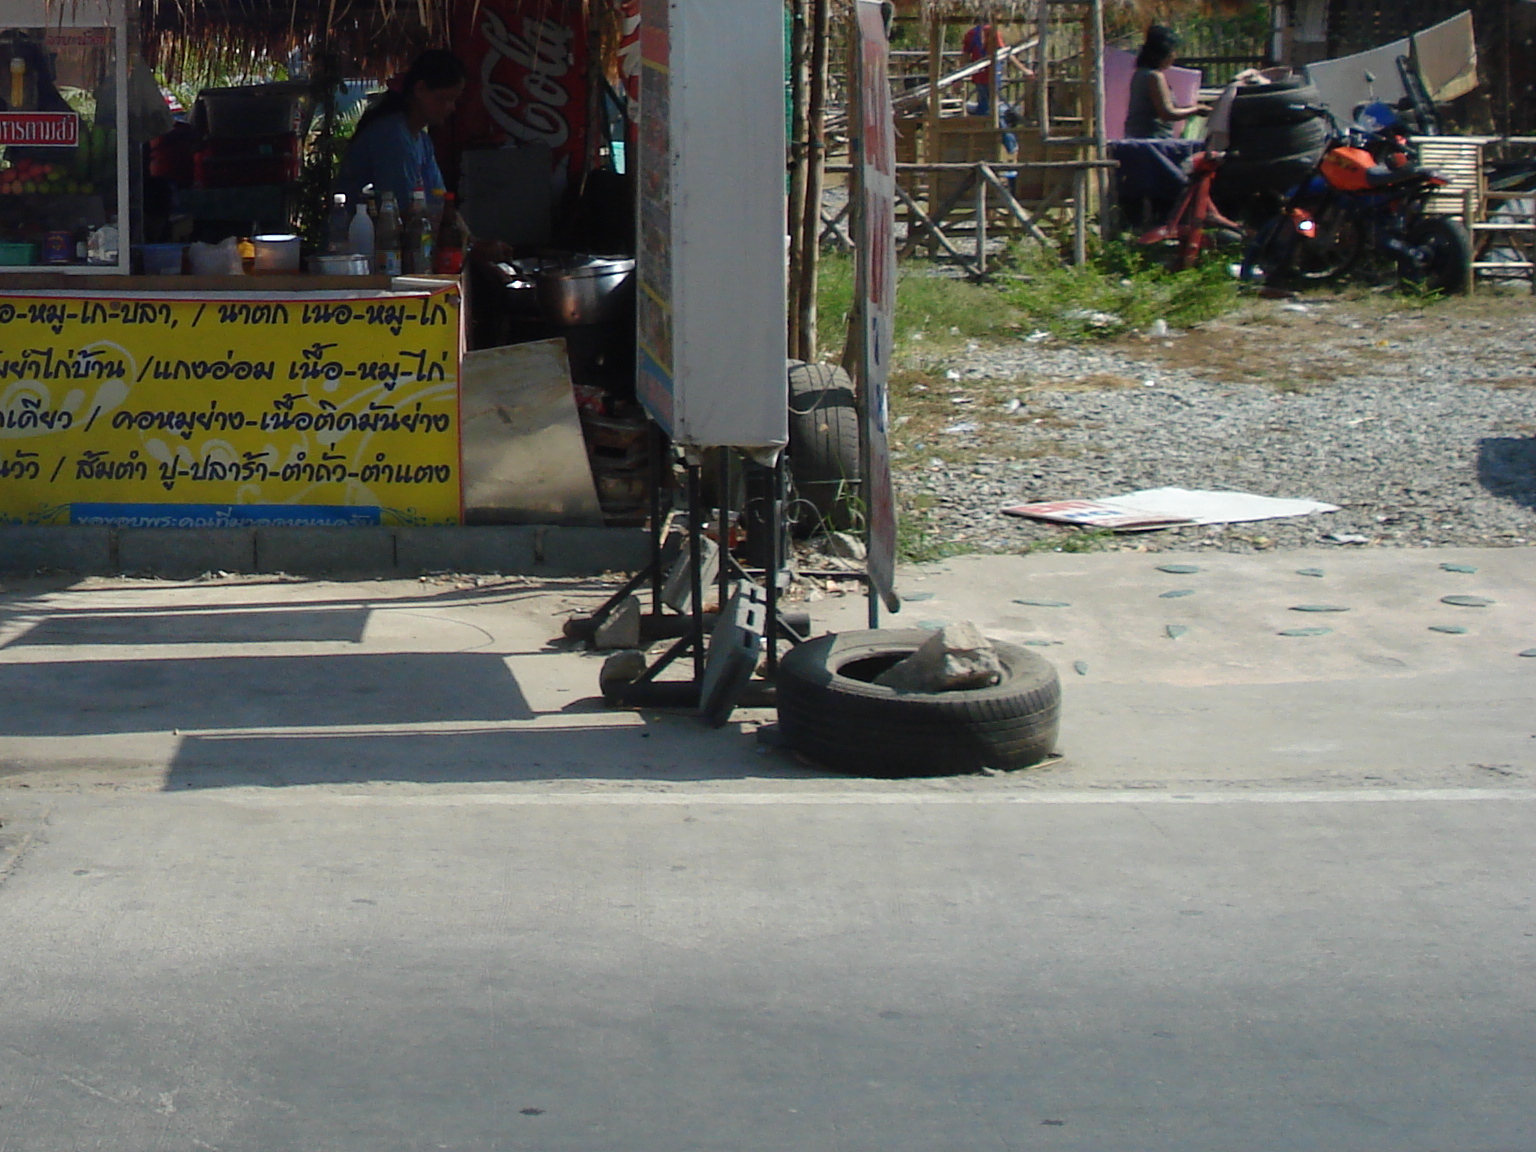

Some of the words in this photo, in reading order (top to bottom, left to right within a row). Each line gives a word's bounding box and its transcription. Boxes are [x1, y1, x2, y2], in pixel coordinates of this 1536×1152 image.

[480, 5, 575, 149] Cola
[289, 343, 449, 391] เนื้อ-หมู-ไก่
[112, 394, 451, 439] คอหมูย่าง-เนื้อติดมันย่าง
[75, 451, 148, 480] ส้มตำ
[159, 443, 451, 490] ปู-ปลาร้า-ตำถั่ว-ตำแตง
